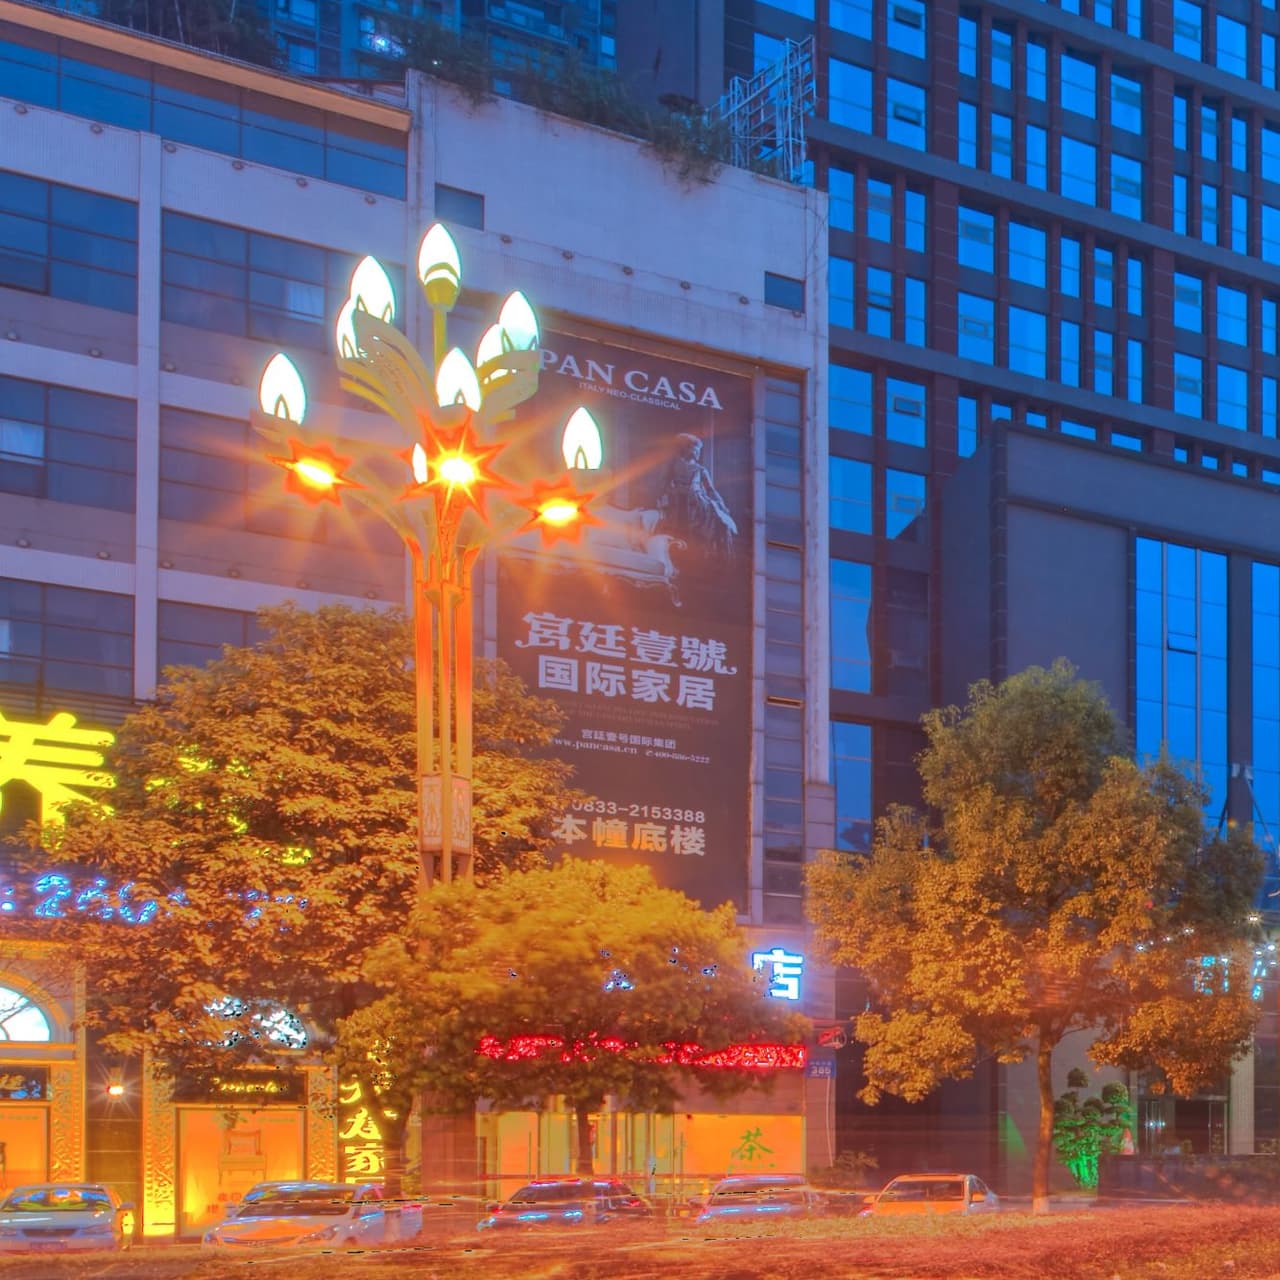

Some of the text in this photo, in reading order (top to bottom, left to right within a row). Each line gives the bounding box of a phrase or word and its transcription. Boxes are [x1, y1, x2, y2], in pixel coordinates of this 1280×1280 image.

[539, 348, 724, 411] PAN CASA
[538, 655, 716, 711] 国际家居
[551, 813, 705, 856] 本幢底楼
[572, 800, 705, 823] 0833-2153388
